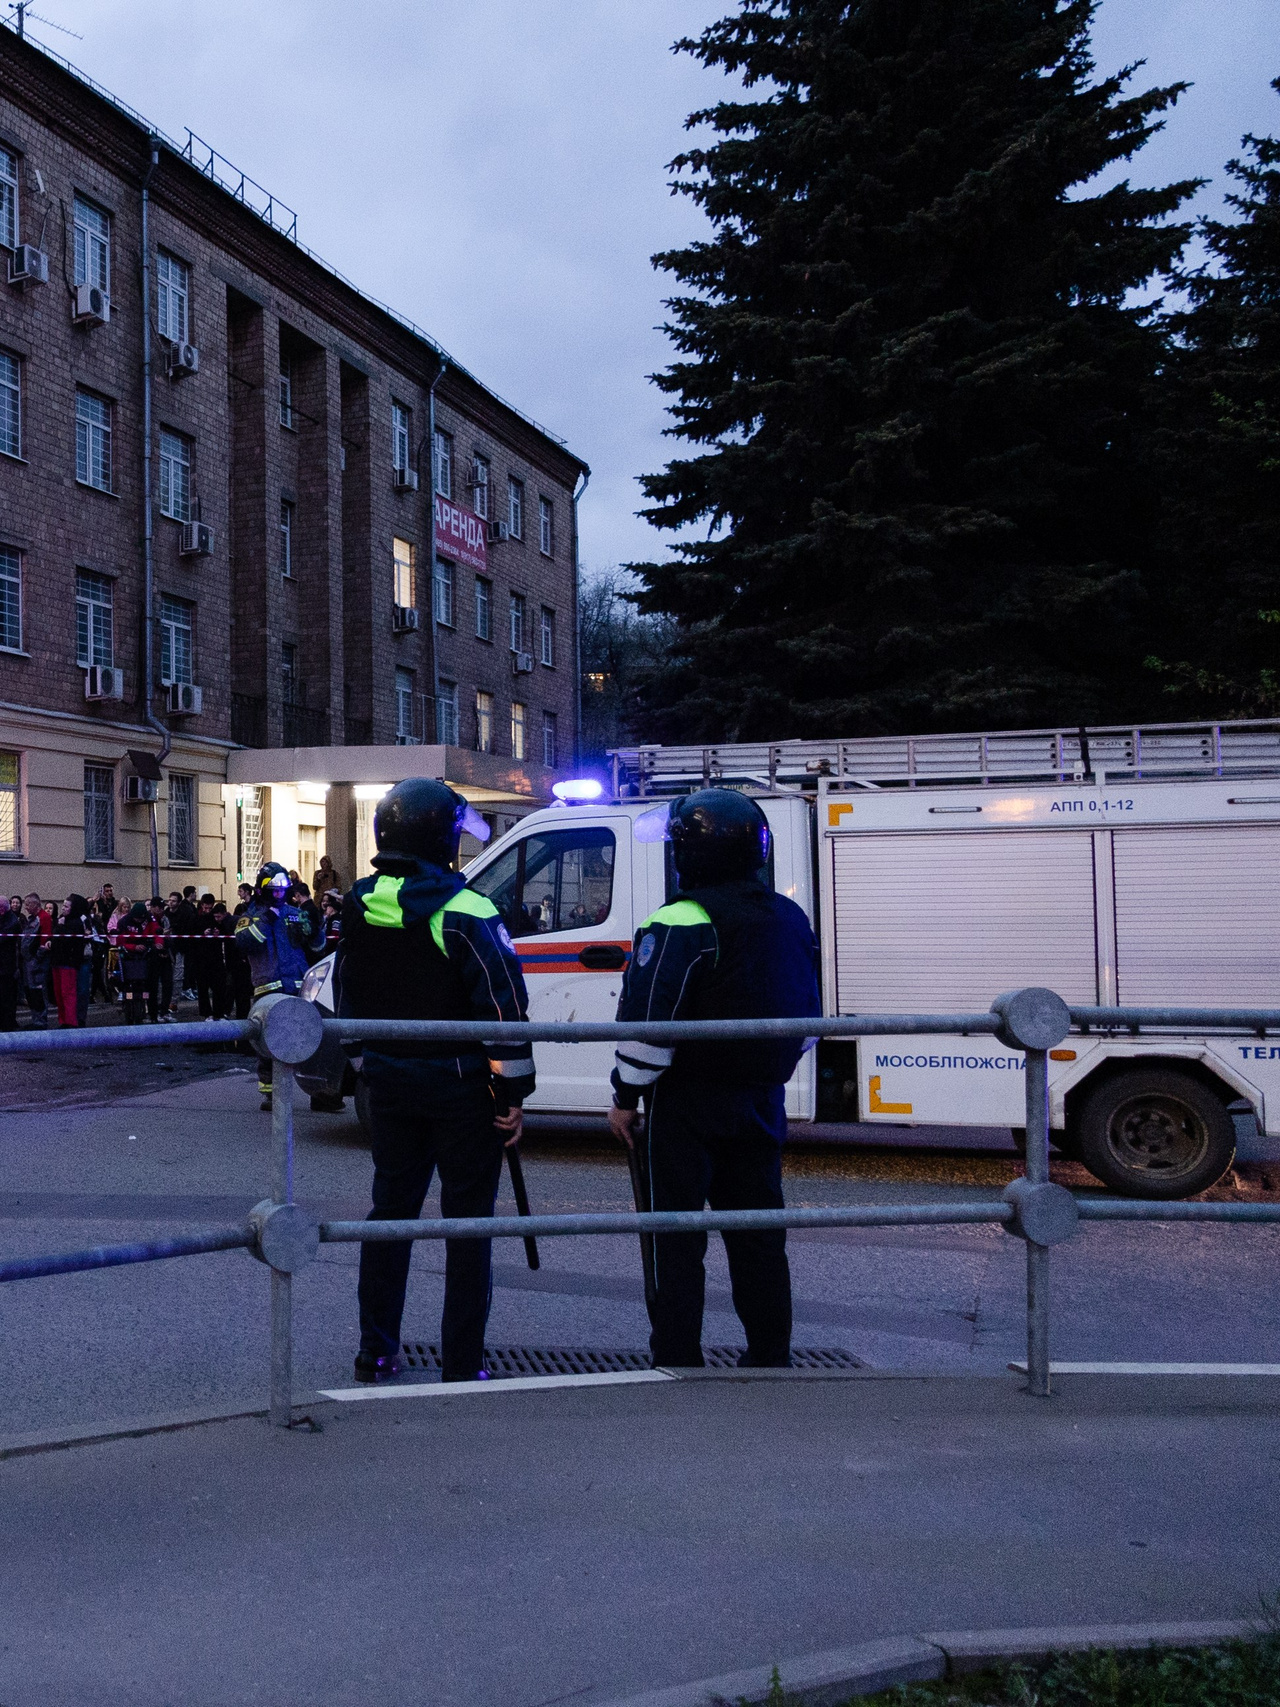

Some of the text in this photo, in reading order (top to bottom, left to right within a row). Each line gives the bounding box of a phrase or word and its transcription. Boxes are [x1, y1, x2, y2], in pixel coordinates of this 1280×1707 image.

[435, 499, 485, 552] АРЕНДА
[1050, 799, 1135, 814] АПП 0,1-12
[1238, 1047, 1280, 1060] ТЕЛ
